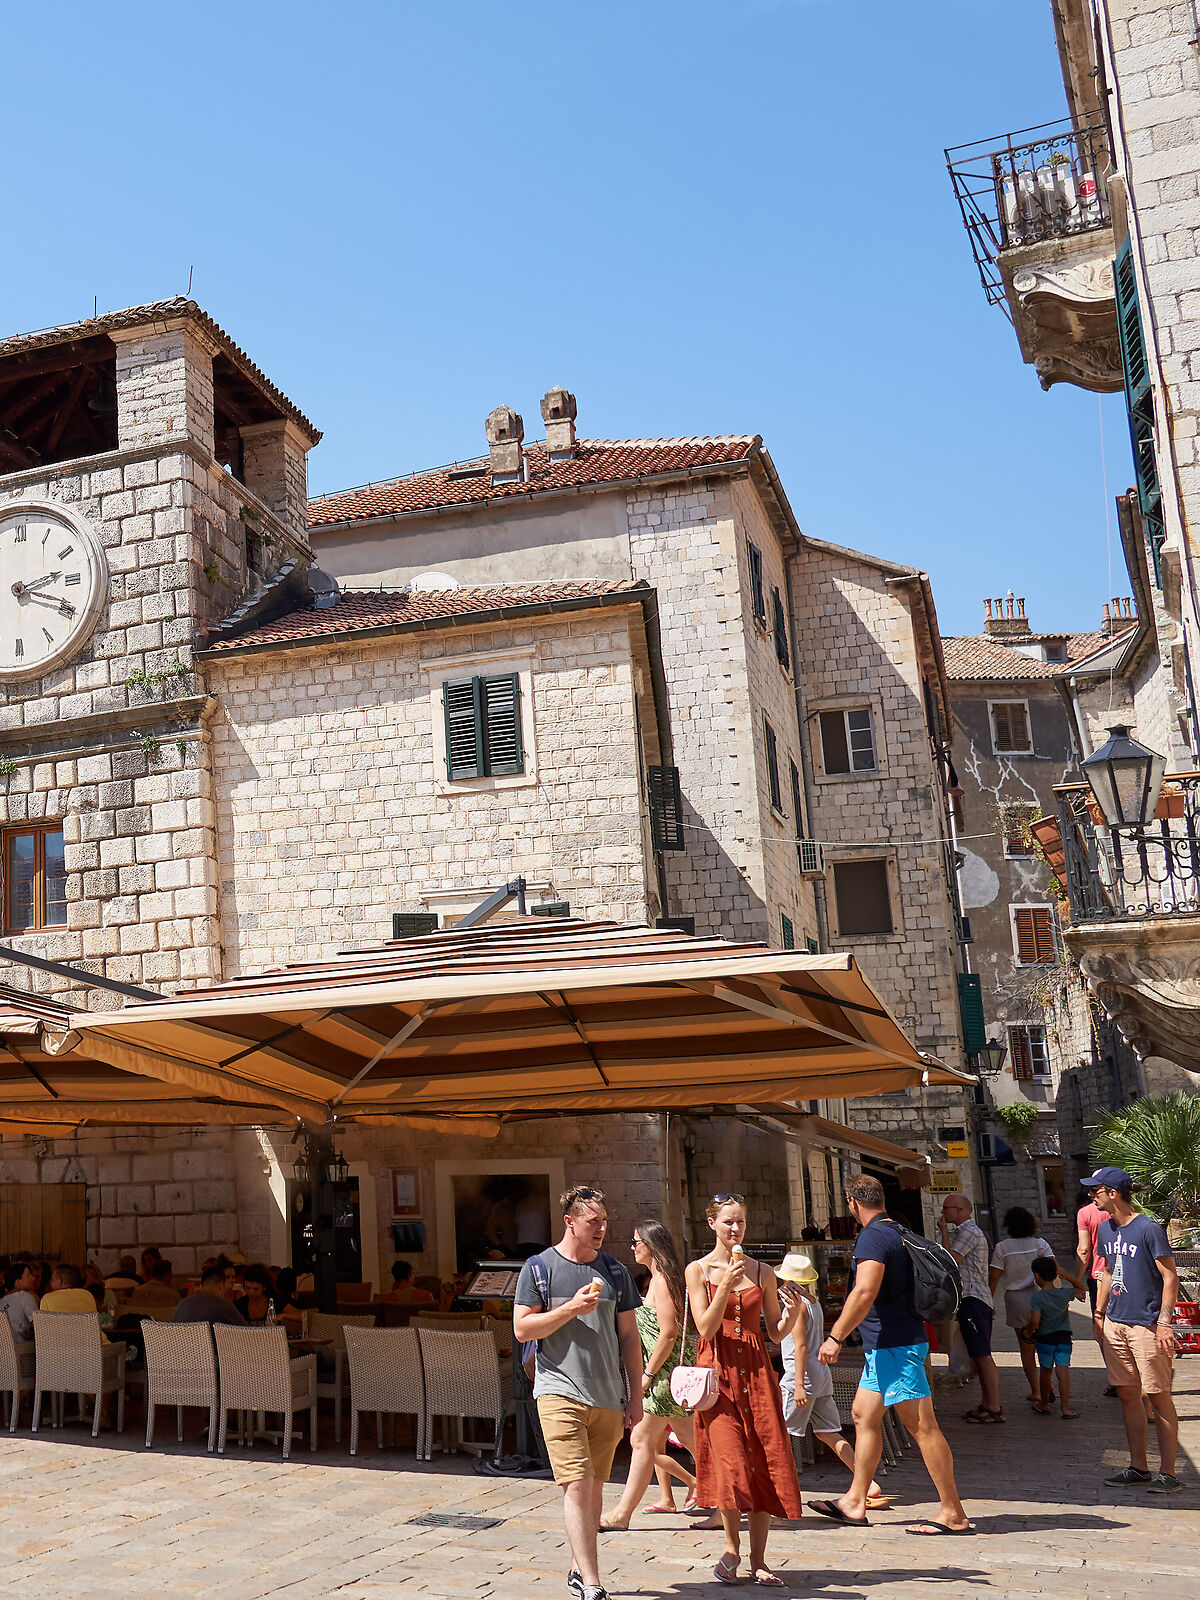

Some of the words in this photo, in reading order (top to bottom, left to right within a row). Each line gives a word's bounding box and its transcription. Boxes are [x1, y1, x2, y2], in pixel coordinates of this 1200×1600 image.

[14, 525, 27, 543] XII
[41, 528, 51, 544] I
[57, 545, 74, 560] II
[65, 573, 80, 586] III
[42, 627, 54, 644] V
